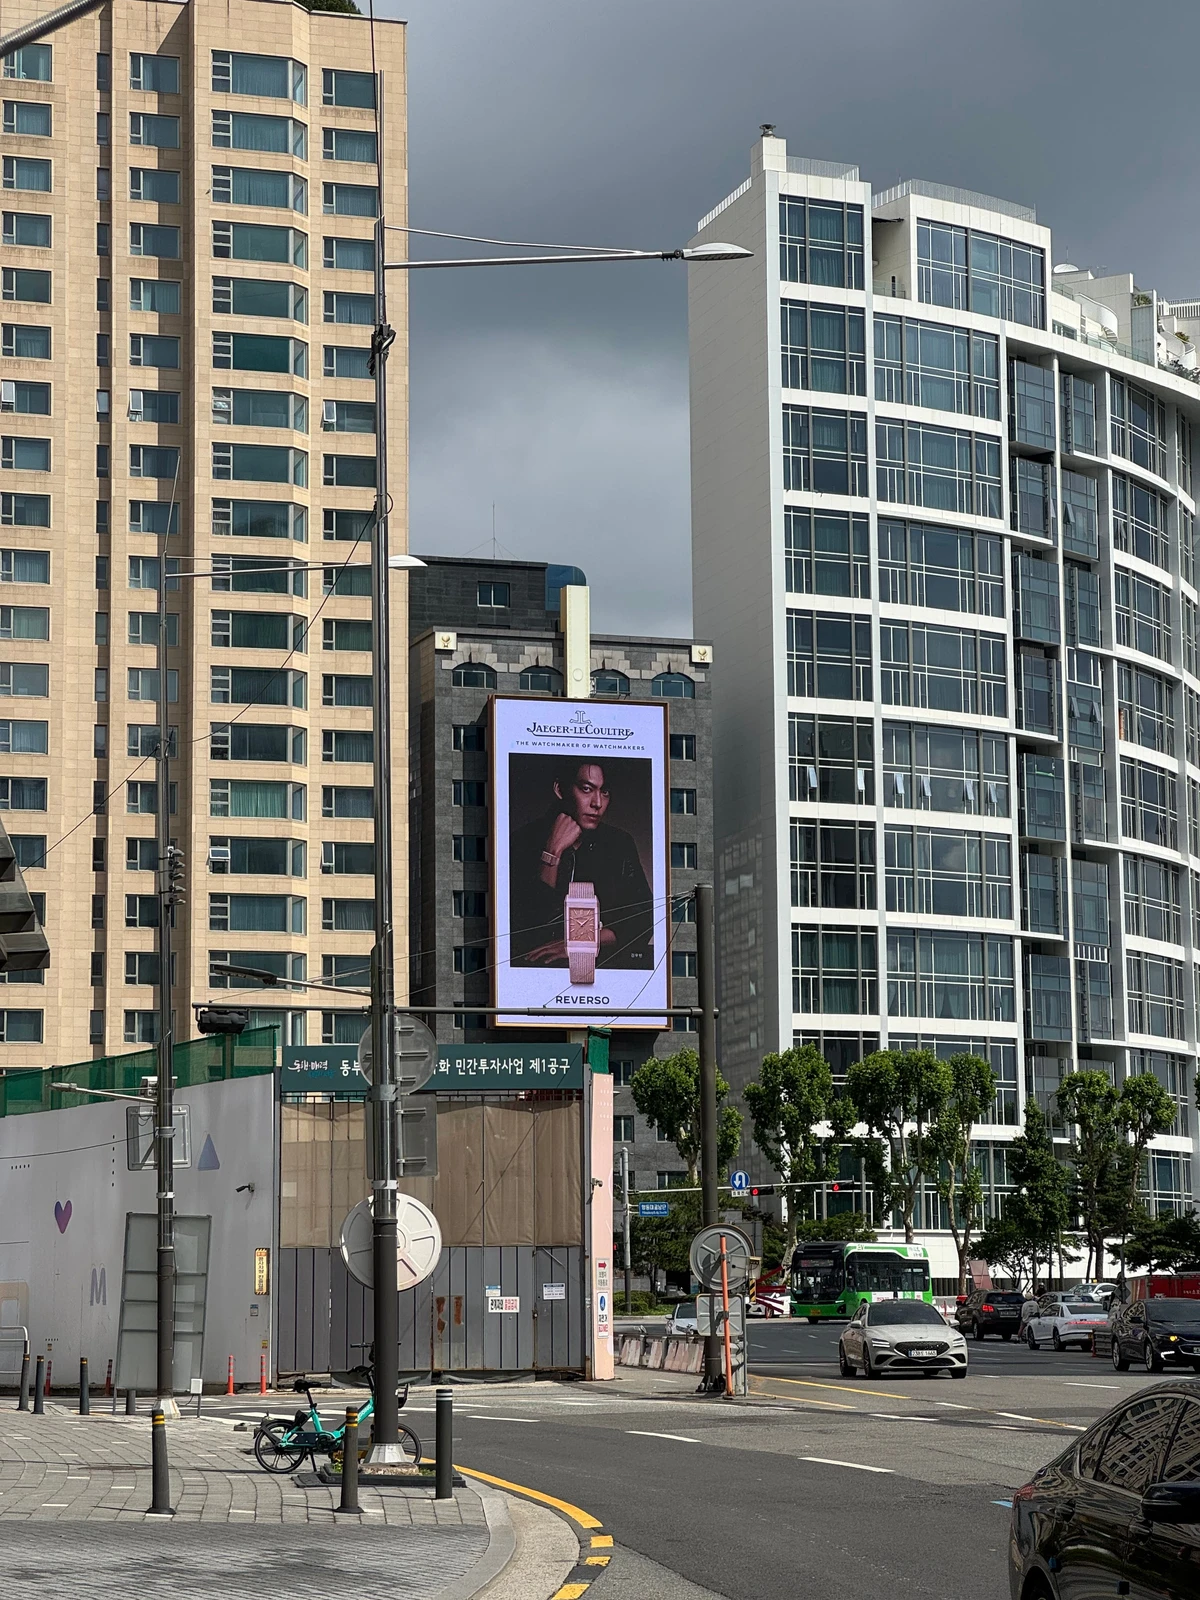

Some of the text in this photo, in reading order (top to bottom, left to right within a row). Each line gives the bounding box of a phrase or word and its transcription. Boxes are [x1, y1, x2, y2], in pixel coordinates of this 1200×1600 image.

[593, 743, 646, 751] WATCHMAKERS
[555, 995, 610, 1005] REVERSO
[455, 1057, 524, 1075] 민간투자사업
[529, 1057, 571, 1075] 제1공구
